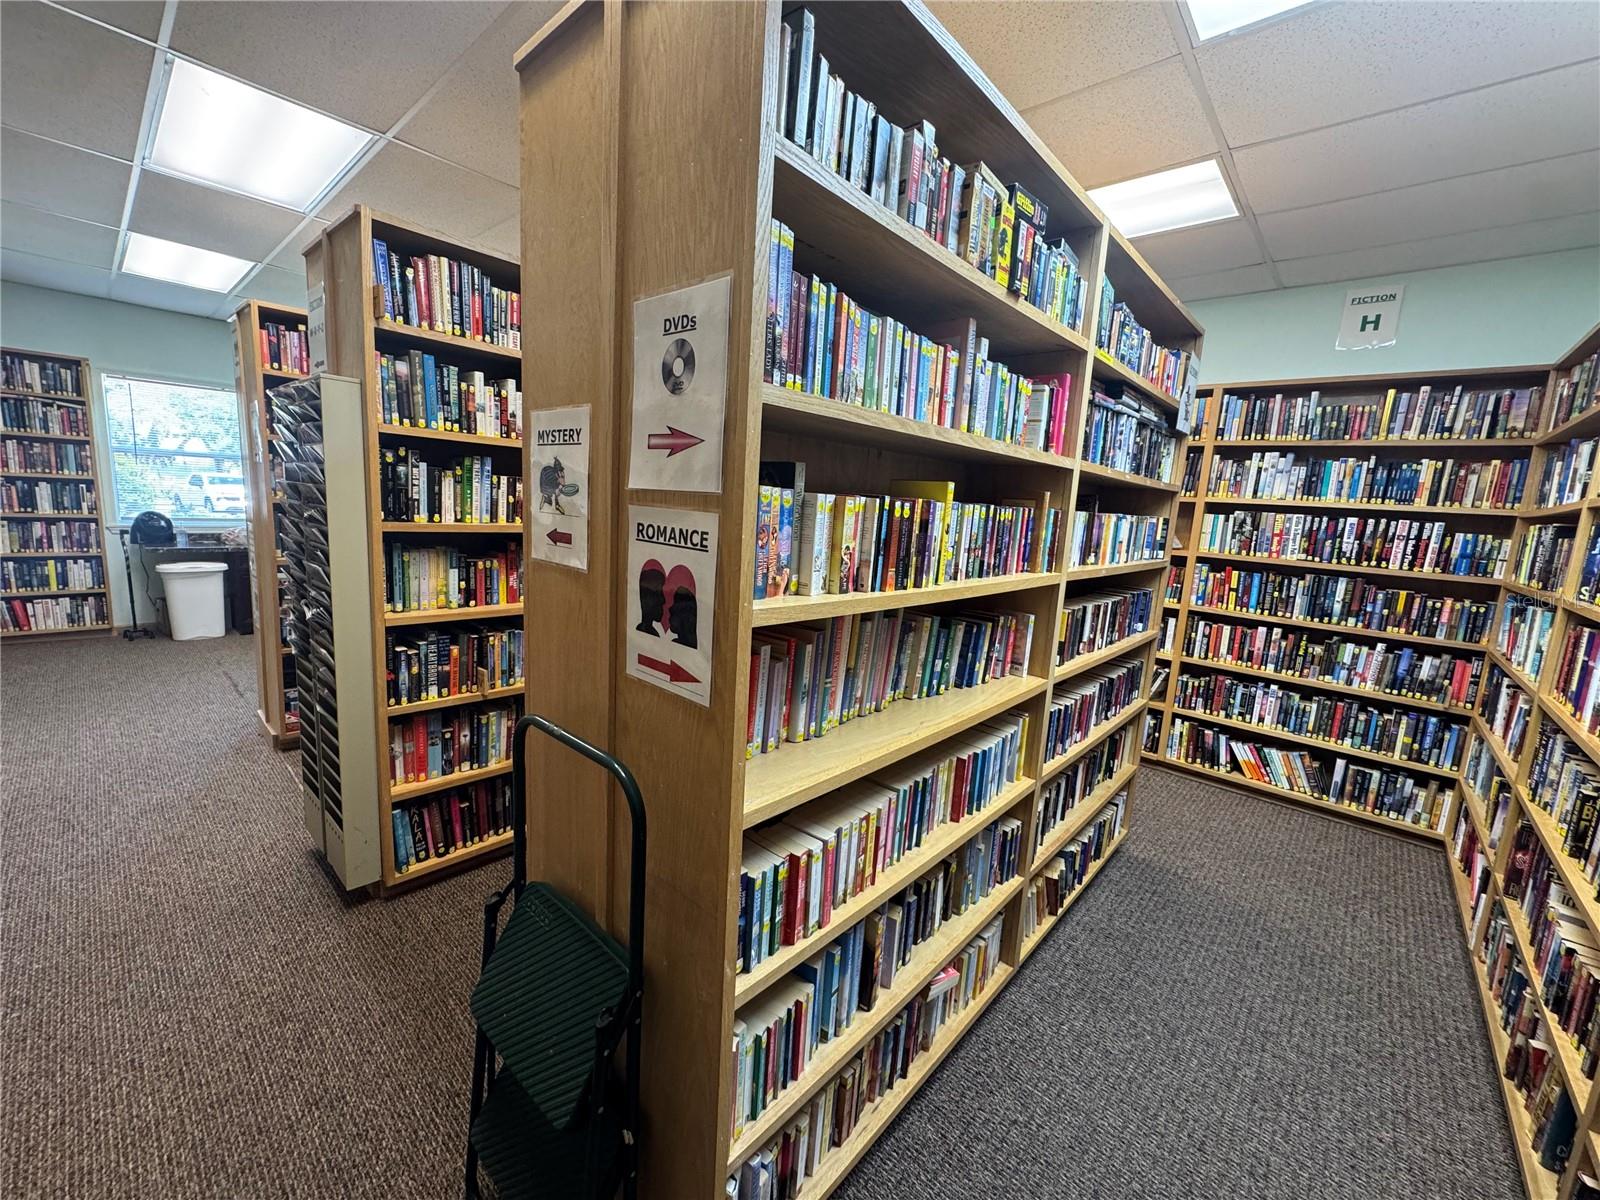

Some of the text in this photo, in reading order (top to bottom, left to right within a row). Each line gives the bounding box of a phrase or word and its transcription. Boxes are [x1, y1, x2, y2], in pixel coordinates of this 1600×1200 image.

[912, 149, 921, 179] MYSTERY
[1350, 293, 1397, 305] FICTION
[663, 314, 697, 334] DVDs
[1359, 313, 1382, 332] H
[537, 428, 582, 444] MYSTERY
[636, 522, 709, 548] ROMANCE
[427, 644, 437, 687] HEARTBROKE
[411, 807, 423, 840] KALA
